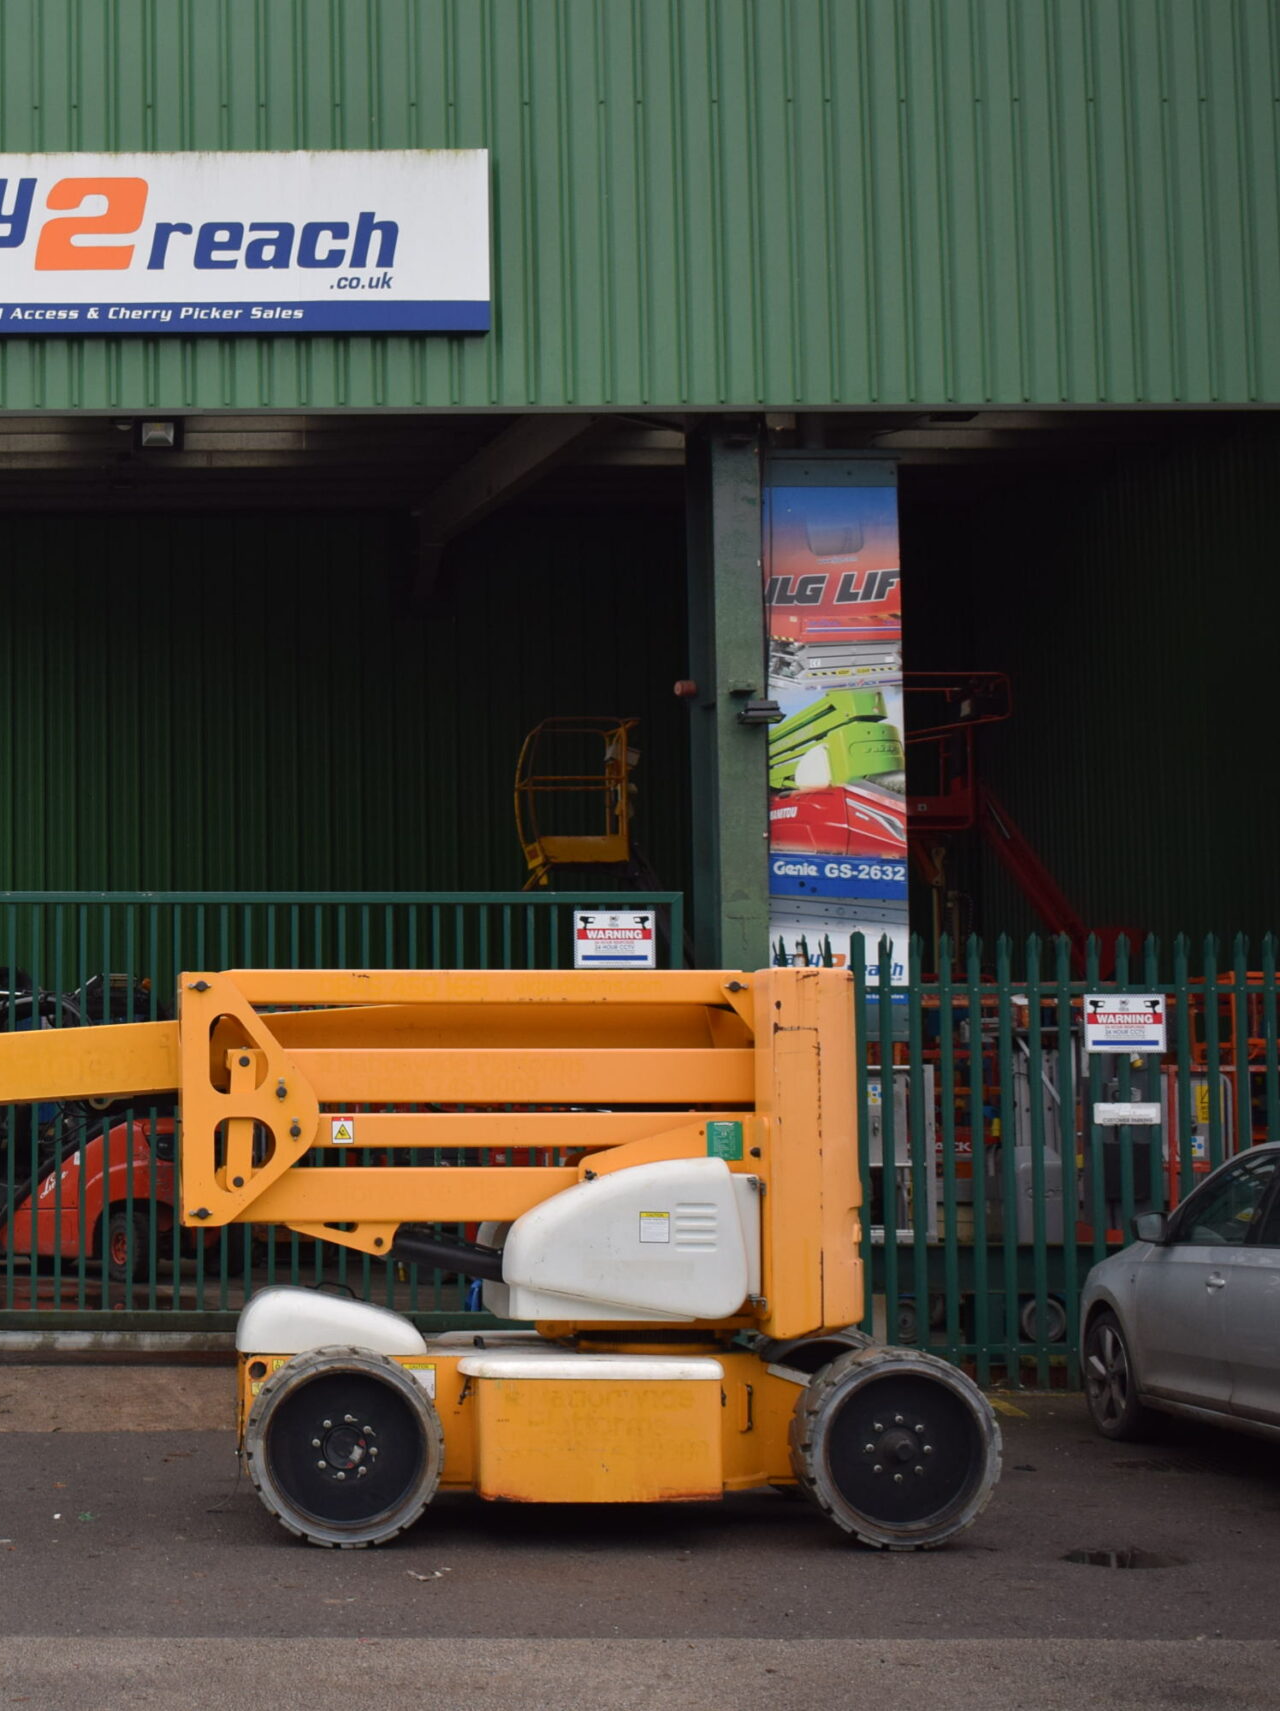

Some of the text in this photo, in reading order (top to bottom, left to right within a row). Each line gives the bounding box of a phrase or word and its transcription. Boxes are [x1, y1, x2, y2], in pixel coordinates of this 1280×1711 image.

[329, 274, 393, 289] .co.uk
[10, 308, 79, 320] Access
[86, 307, 100, 319] &
[108, 307, 173, 322] Cherry
[179, 307, 243, 320] Picker
[250, 306, 304, 319] Sales
[773, 861, 906, 881] Genie GS-2632
[587, 929, 643, 939] WARNING
[1096, 1014, 1154, 1024] WARNING
